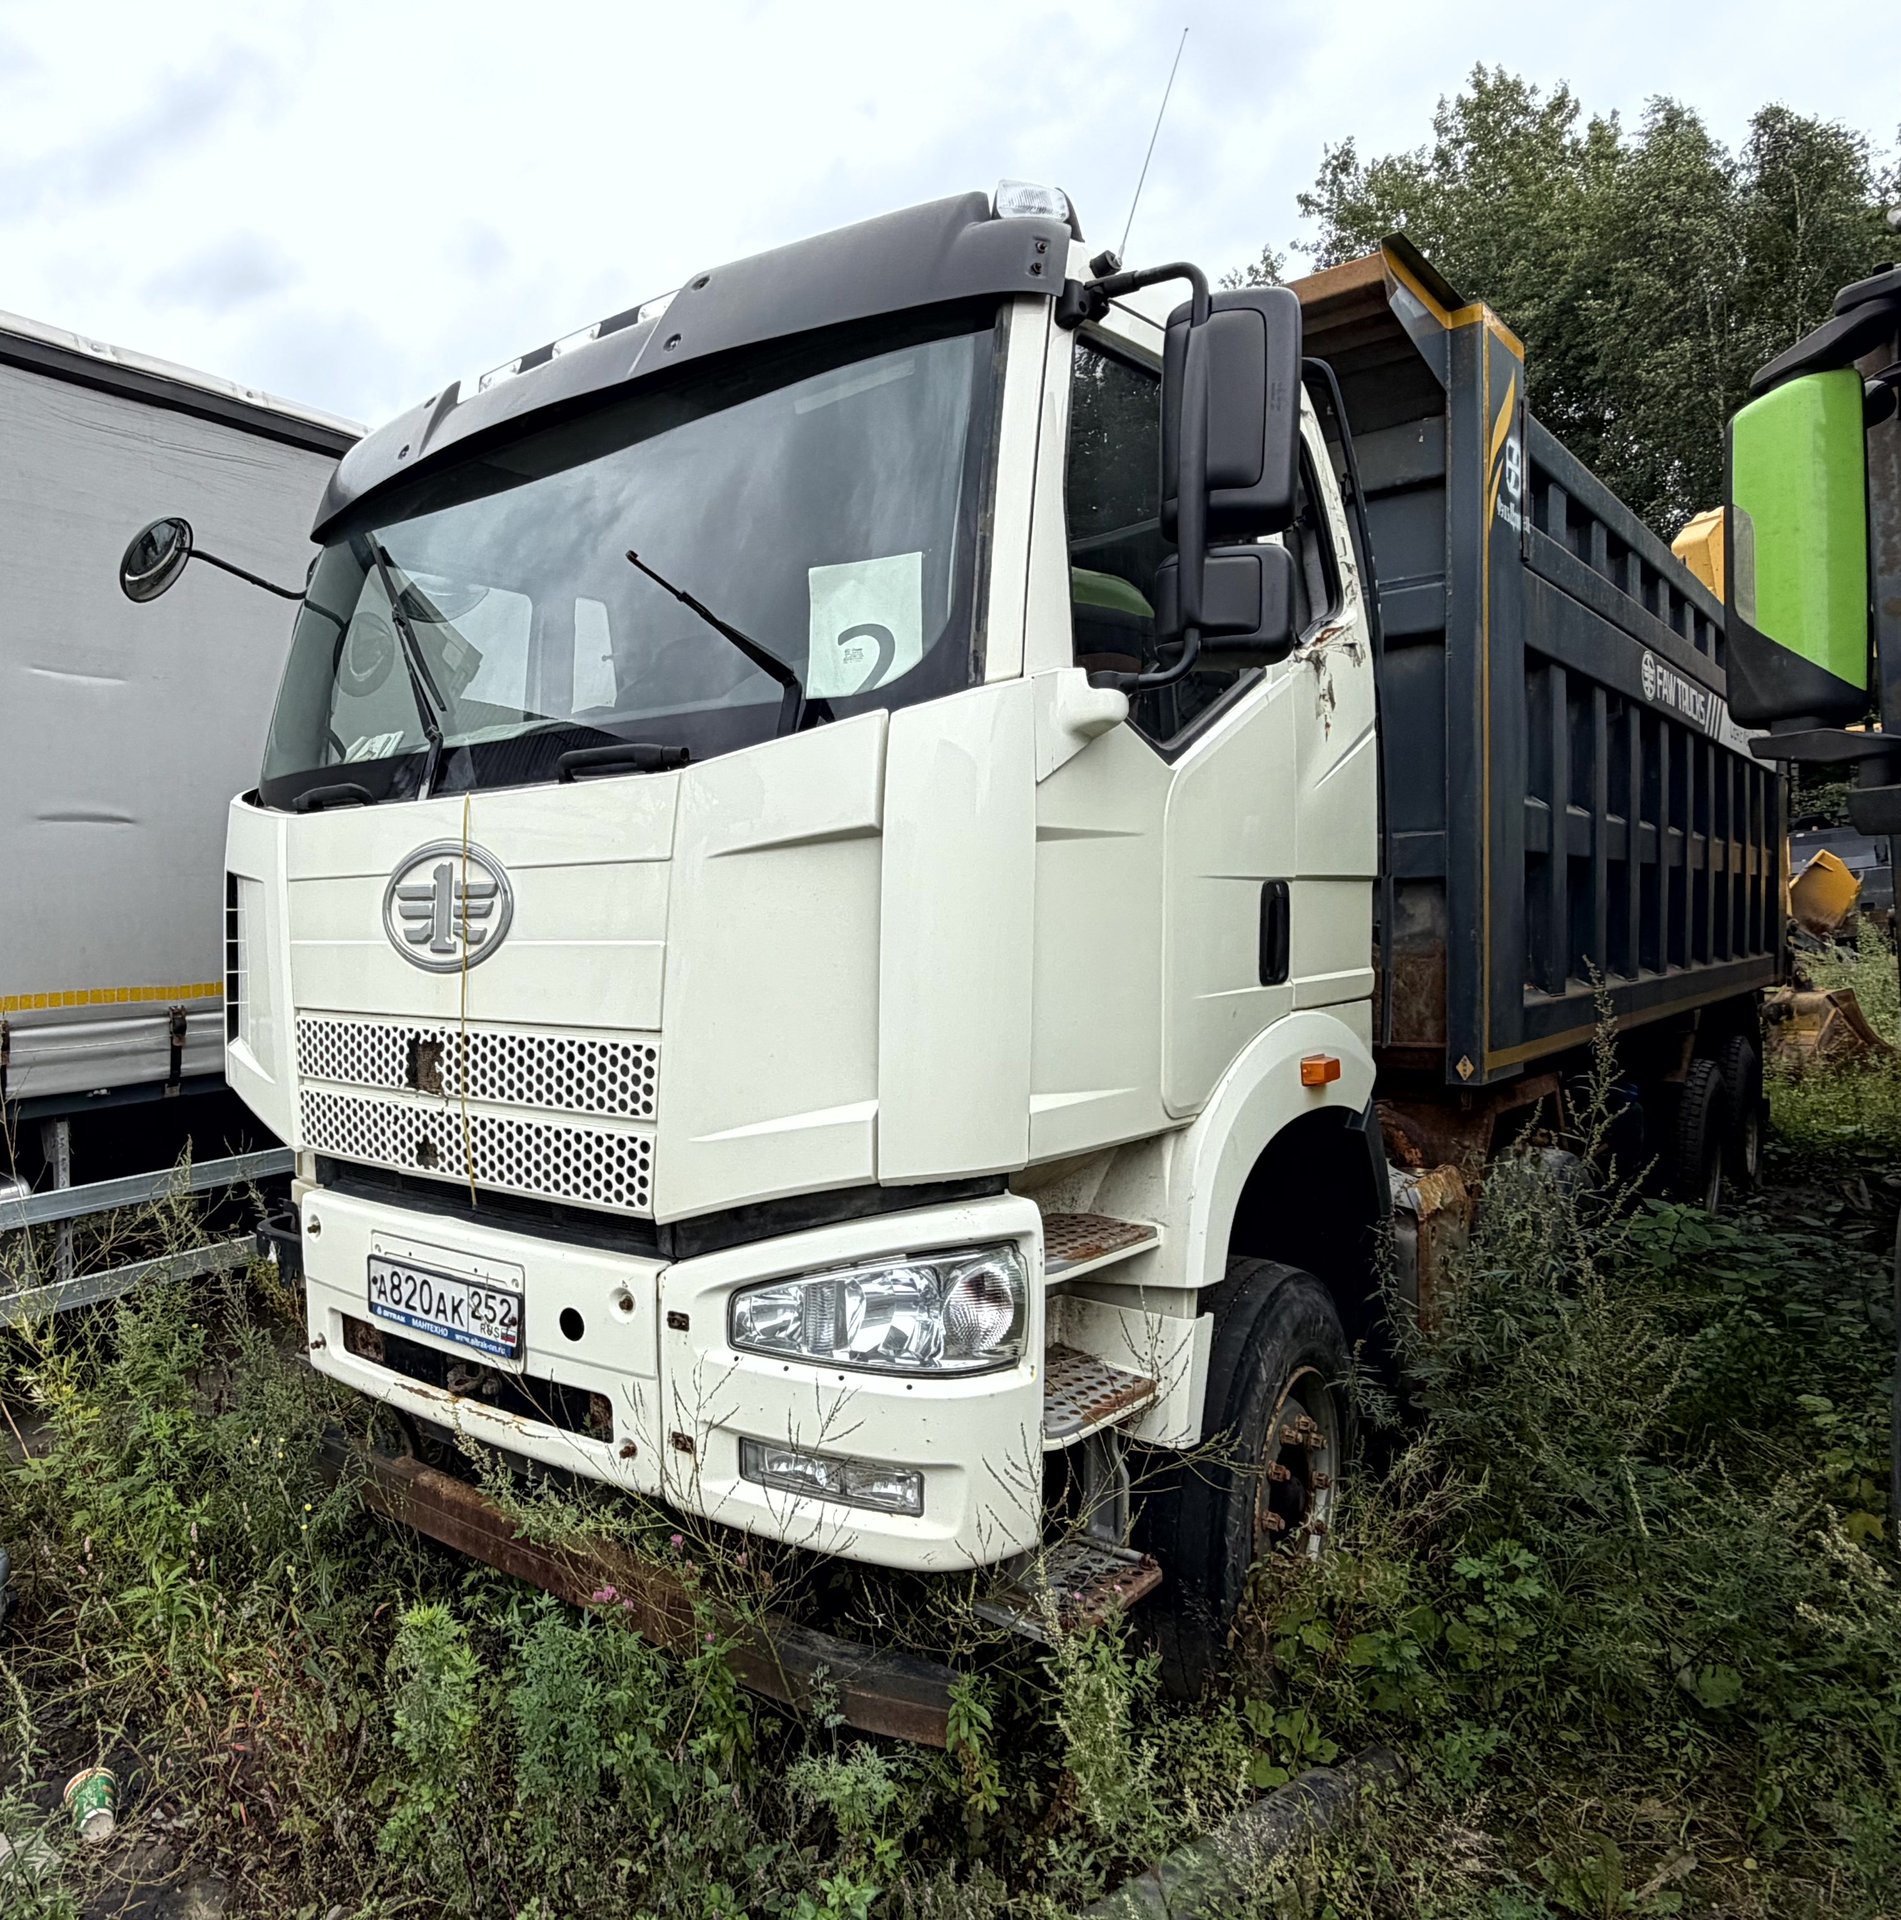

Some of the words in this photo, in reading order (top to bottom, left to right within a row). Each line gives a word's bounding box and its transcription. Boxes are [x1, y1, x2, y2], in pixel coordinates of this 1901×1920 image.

[1655, 664, 1677, 707] FAW
[1677, 677, 1706, 726] TRUCKS
[377, 1270, 465, 1328] А820АК
[470, 1290, 513, 1328] 252
[411, 1318, 449, 1337] МАНТЕХНО
[480, 1323, 500, 1339] RUS
